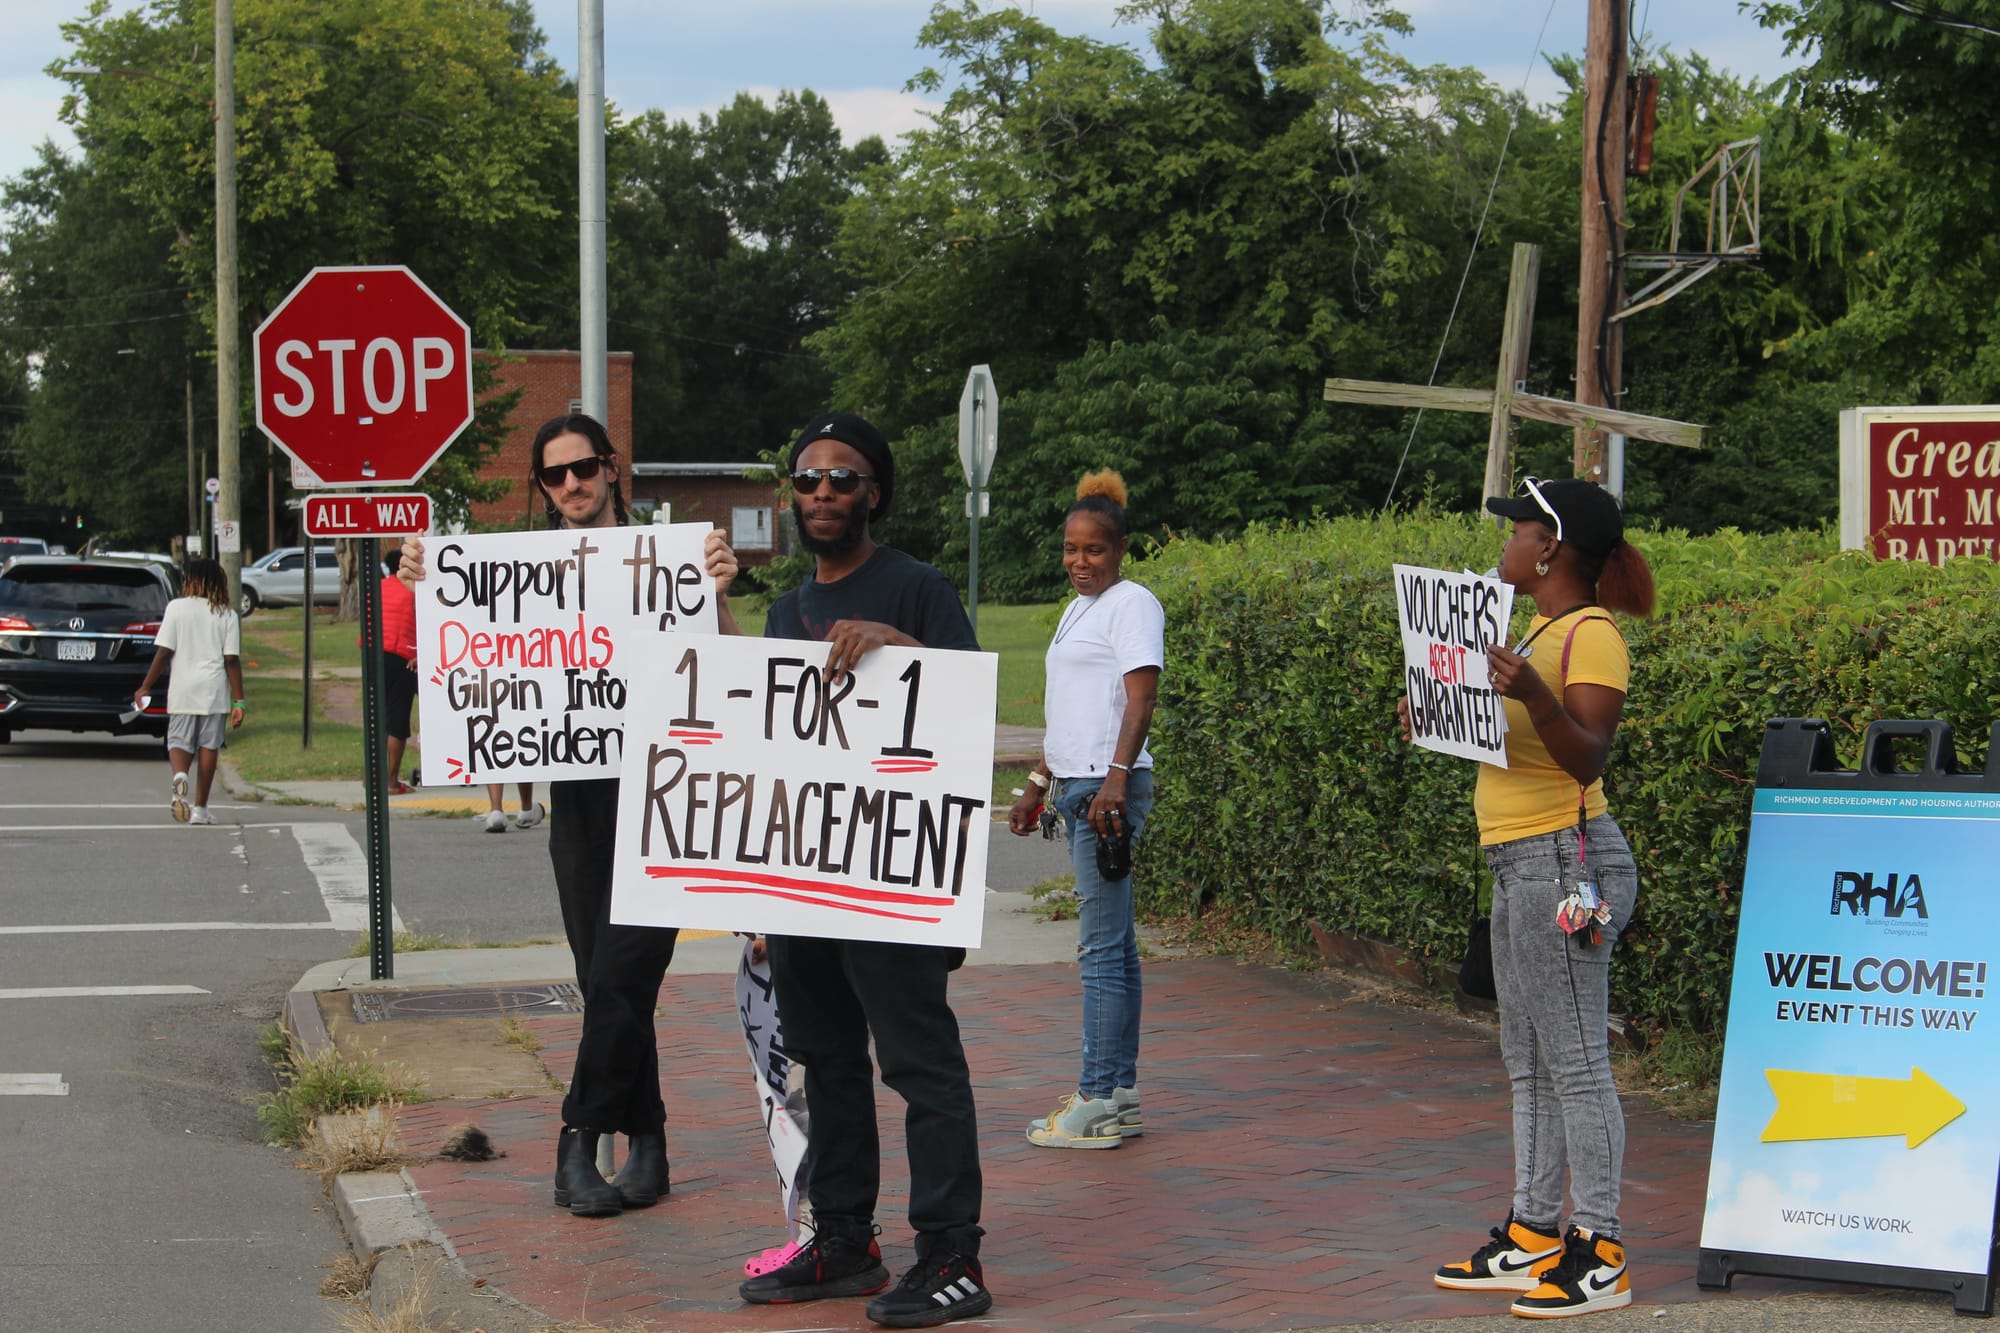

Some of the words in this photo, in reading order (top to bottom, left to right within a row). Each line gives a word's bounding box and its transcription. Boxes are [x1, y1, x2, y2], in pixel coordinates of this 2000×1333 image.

[273, 337, 454, 417] STOP
[1887, 428, 2000, 478] Grea
[316, 504, 358, 528] ALL
[377, 503, 420, 527] WAY
[1888, 486, 1946, 525] MT.
[1964, 488, 2000, 526] M
[1887, 536, 2000, 568] BAPTI
[436, 536, 599, 623] Support
[623, 534, 705, 616] the
[1401, 573, 1499, 655] VOUCHERS
[439, 613, 614, 670] Demands
[1429, 641, 1467, 685] AREN'T
[448, 667, 543, 723] Gilpin
[564, 668, 628, 712] Info
[1408, 666, 1503, 752] GUARANTEED
[467, 713, 624, 774] Residen
[641, 743, 985, 896] REPLACEMENT
[1774, 795, 1821, 804] RICHMOND
[1822, 796, 1897, 806] REDEVELOPMENT
[1899, 798, 1918, 807] AND
[1921, 799, 1962, 808] HOUSING
[1764, 952, 1987, 999] WELCOME!
[1776, 1000, 1854, 1024] EVENT
[1859, 1005, 1914, 1028] THIS
[1921, 1008, 1978, 1031] WAY
[1782, 1209, 1836, 1227] WATCH
[1839, 1214, 1860, 1229] US
[1863, 1216, 1913, 1234] WORK.
